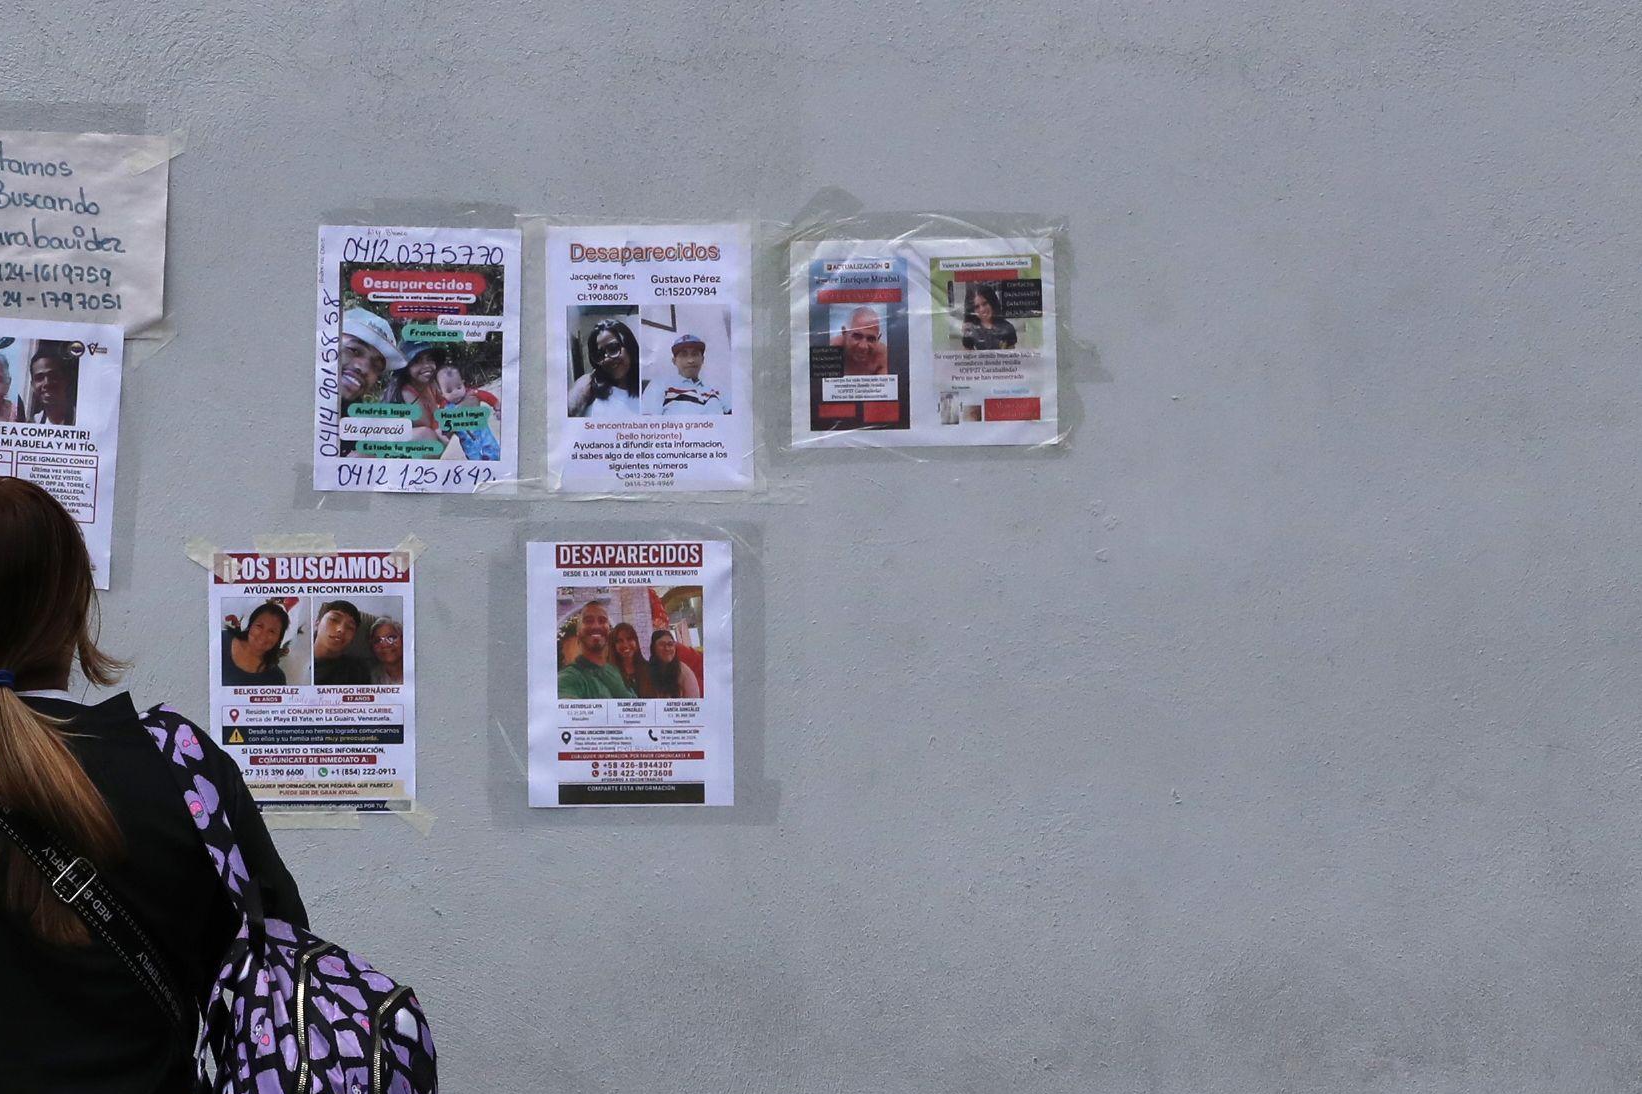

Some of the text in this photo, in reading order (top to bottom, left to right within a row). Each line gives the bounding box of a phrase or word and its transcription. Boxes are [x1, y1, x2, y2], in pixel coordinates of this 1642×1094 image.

[343, 238, 394, 264] 0412
[569, 242, 721, 266] Desaparecidos
[569, 272, 636, 282] Jacqueline flores
[650, 274, 721, 284] Gustavo Pérez
[362, 276, 473, 293] Desaparecidos
[587, 283, 619, 291] 39 años
[409, 329, 459, 338] Francesca
[10, 427, 18, 436] A
[21, 427, 91, 440] COMPARTIR!
[342, 423, 405, 437] Ya apareció
[0, 438, 13, 447] MI
[15, 439, 54, 450] ABUELA
[55, 440, 63, 450] Y
[64, 441, 77, 451] MI
[78, 440, 98, 452] TÍO.
[20, 454, 37, 463] JOSE
[38, 456, 67, 465] IGNACIO
[338, 463, 389, 486] 0412
[559, 544, 700, 565] DESAPARECIDOS
[275, 555, 403, 580] BUSCAMOS!
[243, 584, 384, 594] AYÚDANOS A ENCONTRARLOS
[259, 686, 300, 695] GONZÁLEZ
[317, 686, 400, 695] SANTIAGO HERNÁNDEZ
[258, 755, 307, 764] COMUNÍCATE
[308, 756, 317, 764] DE
[319, 756, 359, 764] INMEDIATO
